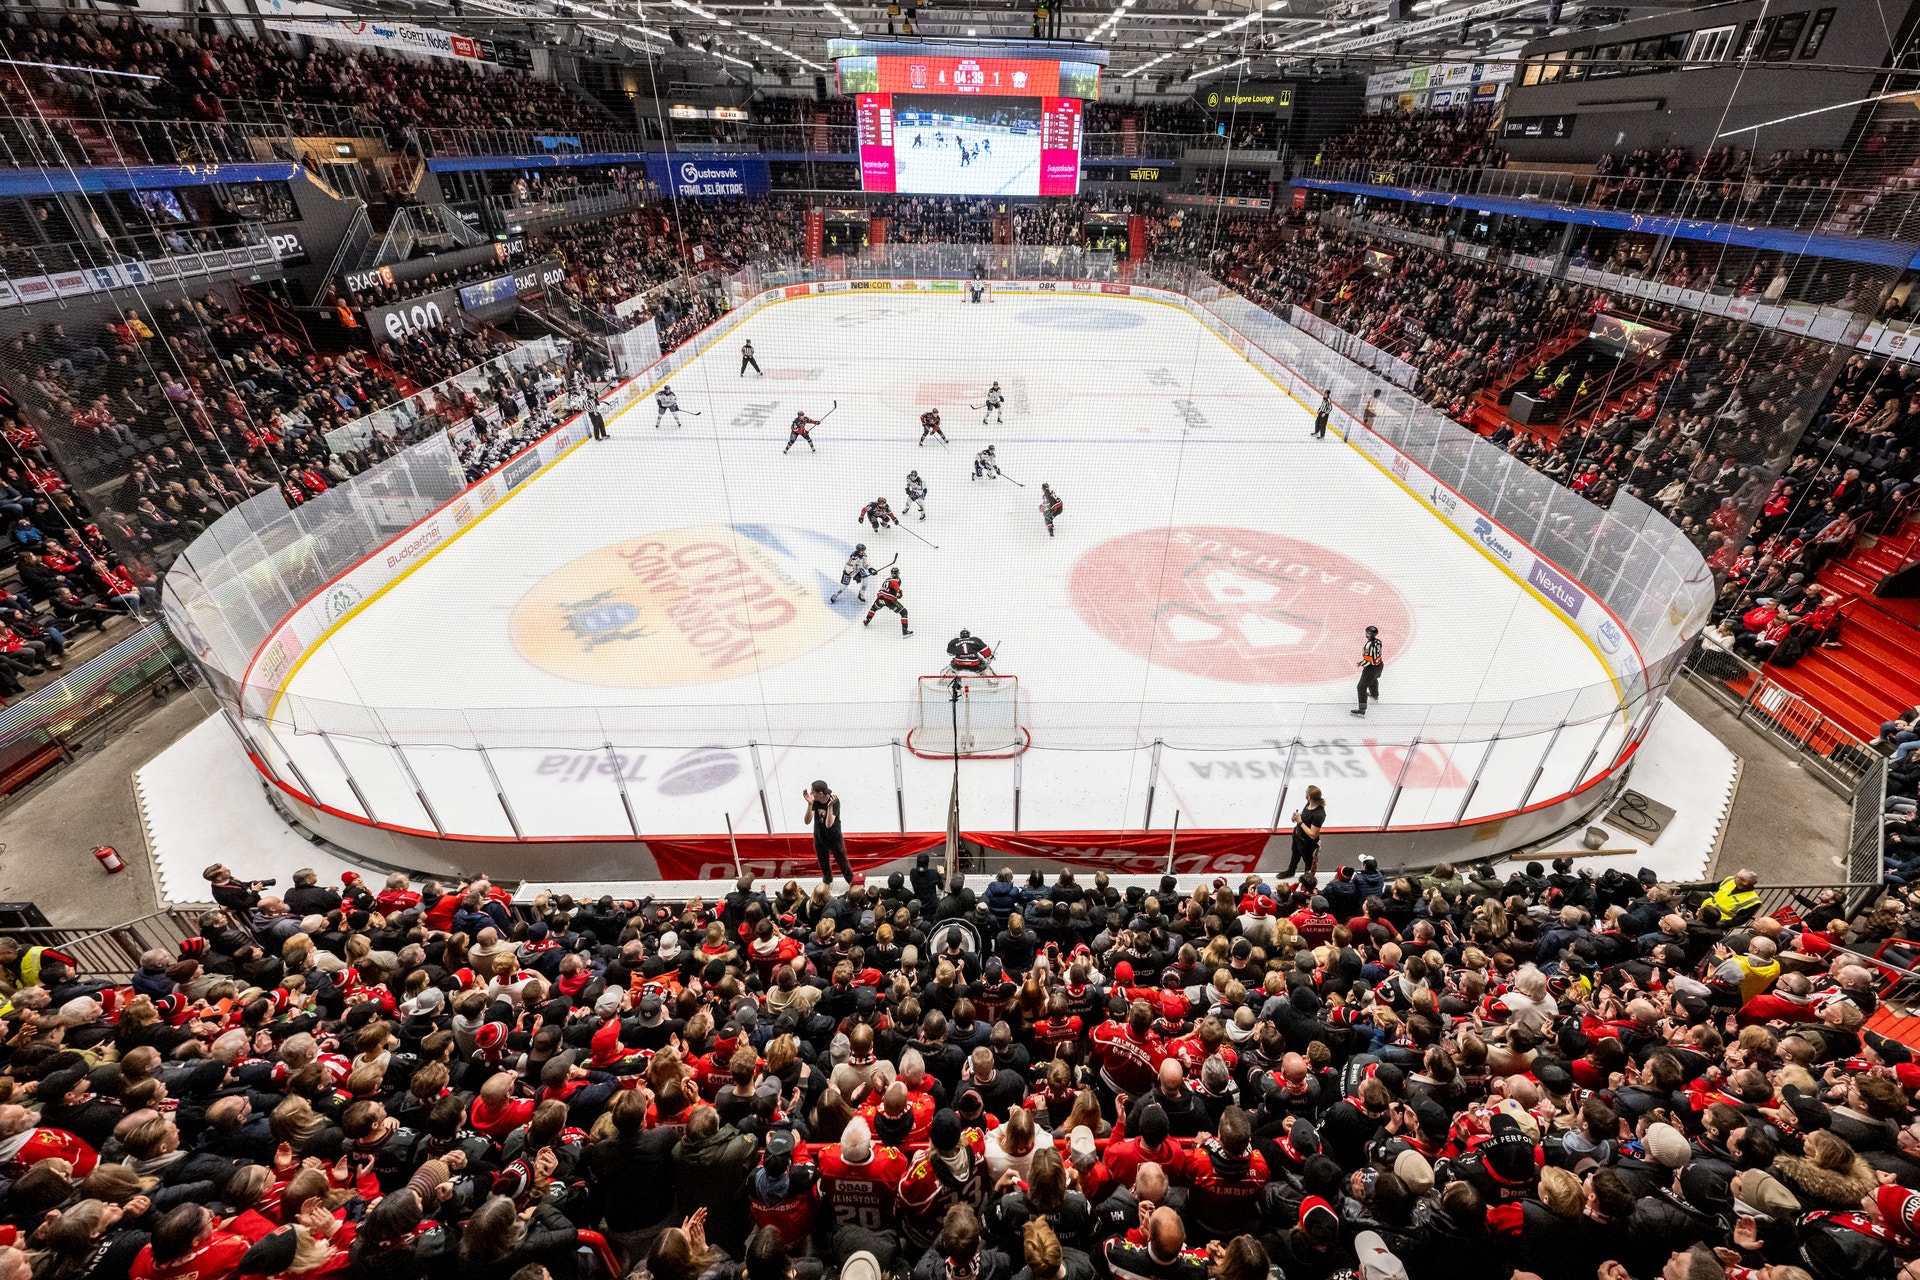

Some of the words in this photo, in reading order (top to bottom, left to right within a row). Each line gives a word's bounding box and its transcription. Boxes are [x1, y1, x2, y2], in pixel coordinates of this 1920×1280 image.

[939, 70, 945, 83] 4
[954, 71, 984, 84] 04:39
[993, 72, 999, 85] 1
[1253, 95, 1275, 104] Lounge
[681, 162, 738, 183] Gustavsvik
[1138, 169, 1159, 180] VIEW
[679, 182, 744, 196] FAMILJELÄKTARE
[501, 240, 525, 256] EXACT
[347, 271, 382, 292] EXACT
[515, 273, 538, 289] EXACT
[386, 525, 440, 568] Budpartner
[1535, 568, 1575, 608] Nextus
[535, 754, 648, 783] Telia
[1189, 759, 1369, 779] SVENSKA
[1112, 1035, 1152, 1062] MALMBERGS
[834, 1206, 882, 1229] 20
[1110, 1210, 1124, 1222] HH
